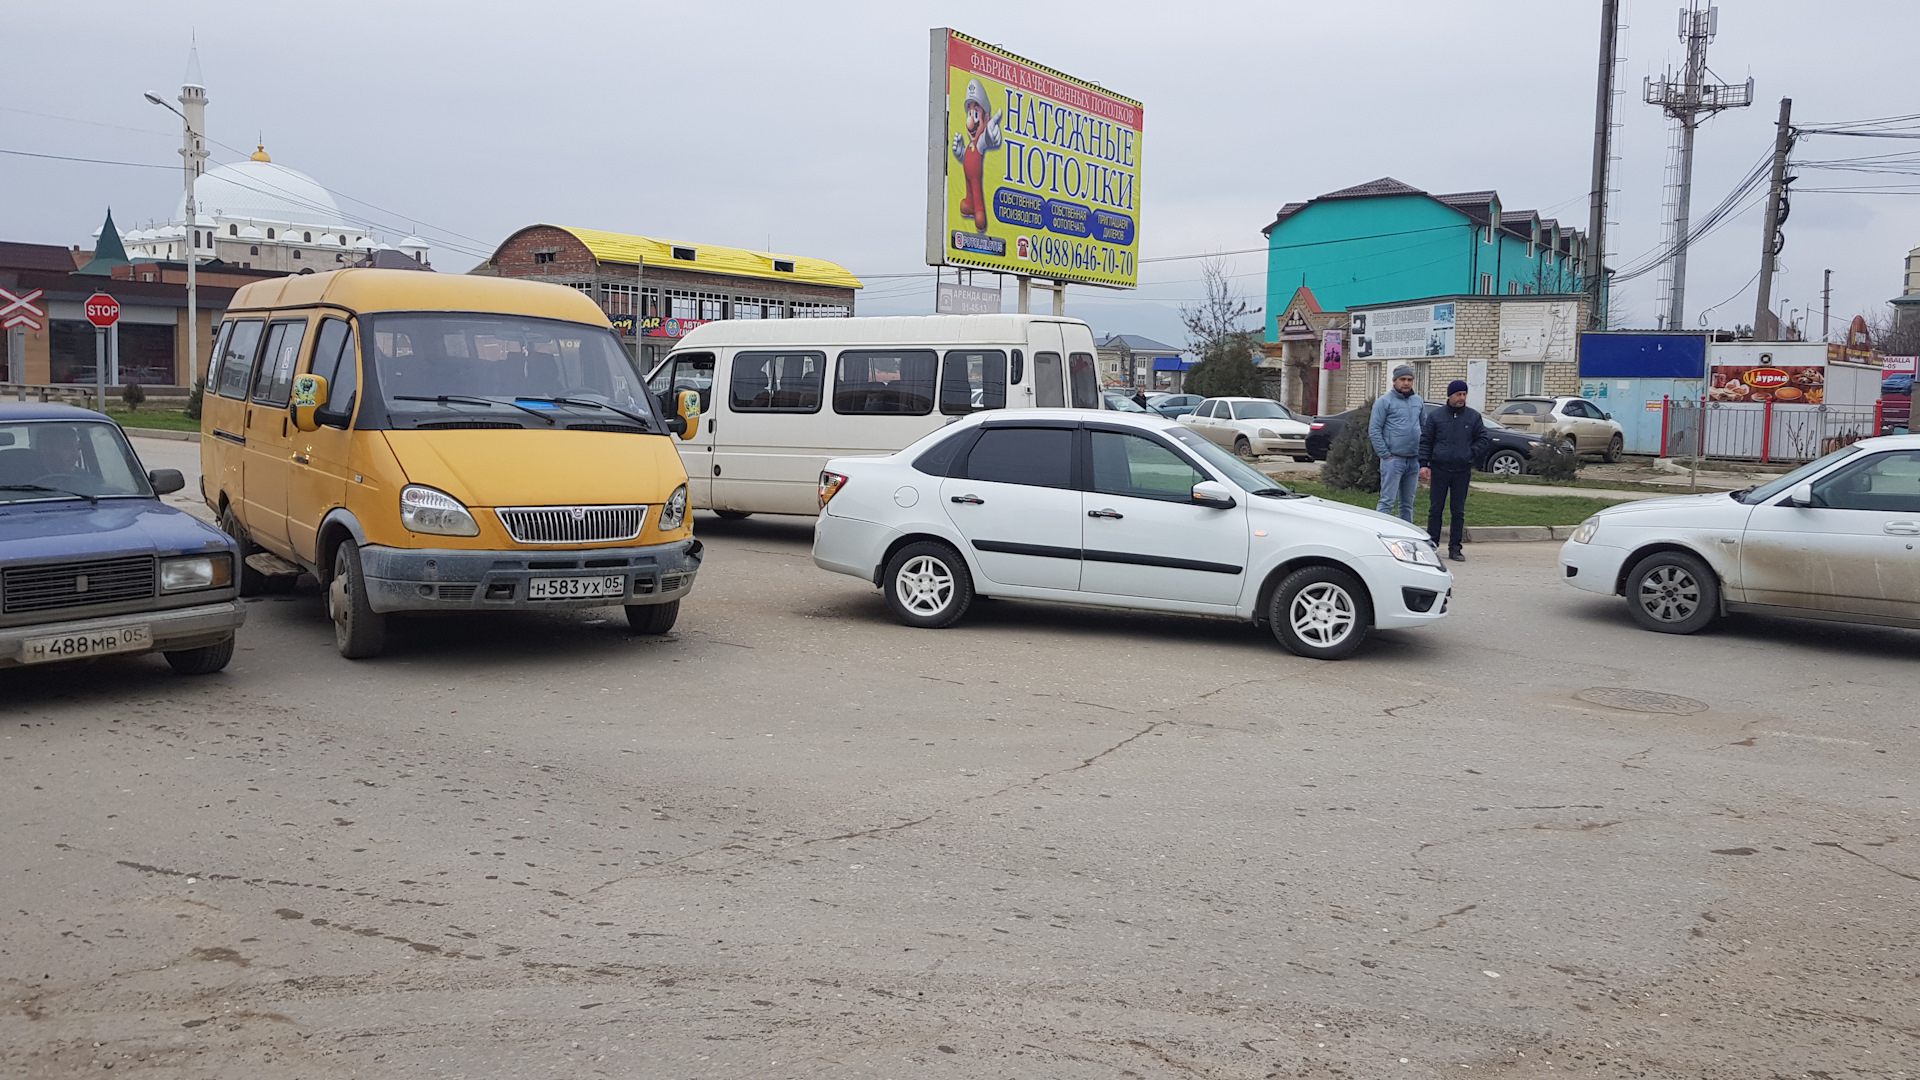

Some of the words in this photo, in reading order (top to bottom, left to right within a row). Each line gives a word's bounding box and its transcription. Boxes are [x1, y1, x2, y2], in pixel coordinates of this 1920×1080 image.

[970, 52, 1018, 88] ФАБРИКА
[1019, 69, 1091, 109] КАЧЕСТВЕННЫХ
[1091, 96, 1134, 124] ПОТОЛКОВ
[1004, 89, 1134, 167] НАТЯЖНЫЕ
[1004, 139, 1135, 210] ПОТОЛКИ
[999, 191, 1042, 211] СОБСТВЕННОЕ
[998, 206, 1042, 225] ПРОИЗВОДСТВО
[1051, 204, 1087, 221] СОБСТВЕННАЯ
[1052, 218, 1086, 233] ФОТОПЕЧАТЬ
[1030, 234, 1133, 277] 8(988)646-70-70
[953, 289, 981, 301] АРЕНДА
[981, 292, 1000, 302] ЩИТА
[87, 304, 118, 317] STOP
[668, 321, 677, 329] 24
[604, 577, 620, 589] 05
[123, 628, 143, 643] 05
